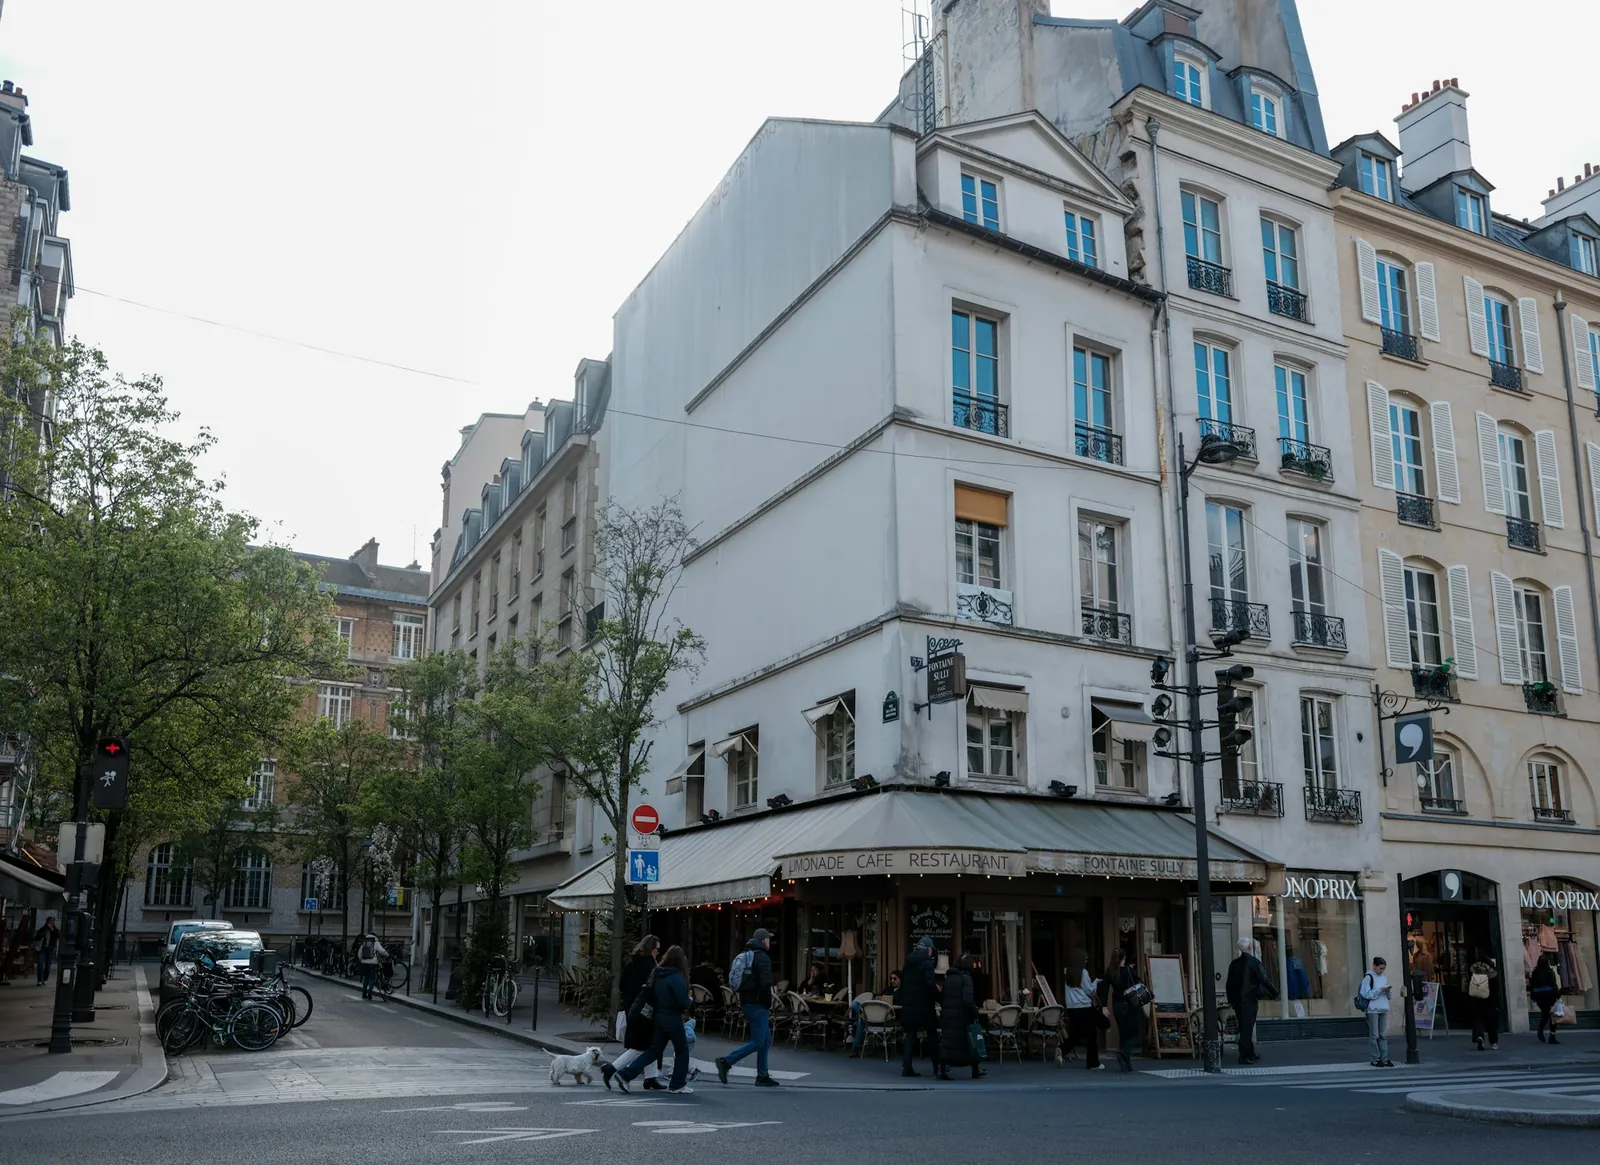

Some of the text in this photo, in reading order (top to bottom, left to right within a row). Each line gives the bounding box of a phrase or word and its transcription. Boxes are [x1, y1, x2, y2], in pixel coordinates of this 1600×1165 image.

[928, 657, 954, 672] FONTAINE
[933, 669, 949, 681] SULLY
[788, 853, 1009, 873] LIMONADE CAFE RESTAURANT
[1084, 856, 1184, 874] FONTAINE SULLY
[1518, 889, 1599, 911] MONOPRIX
